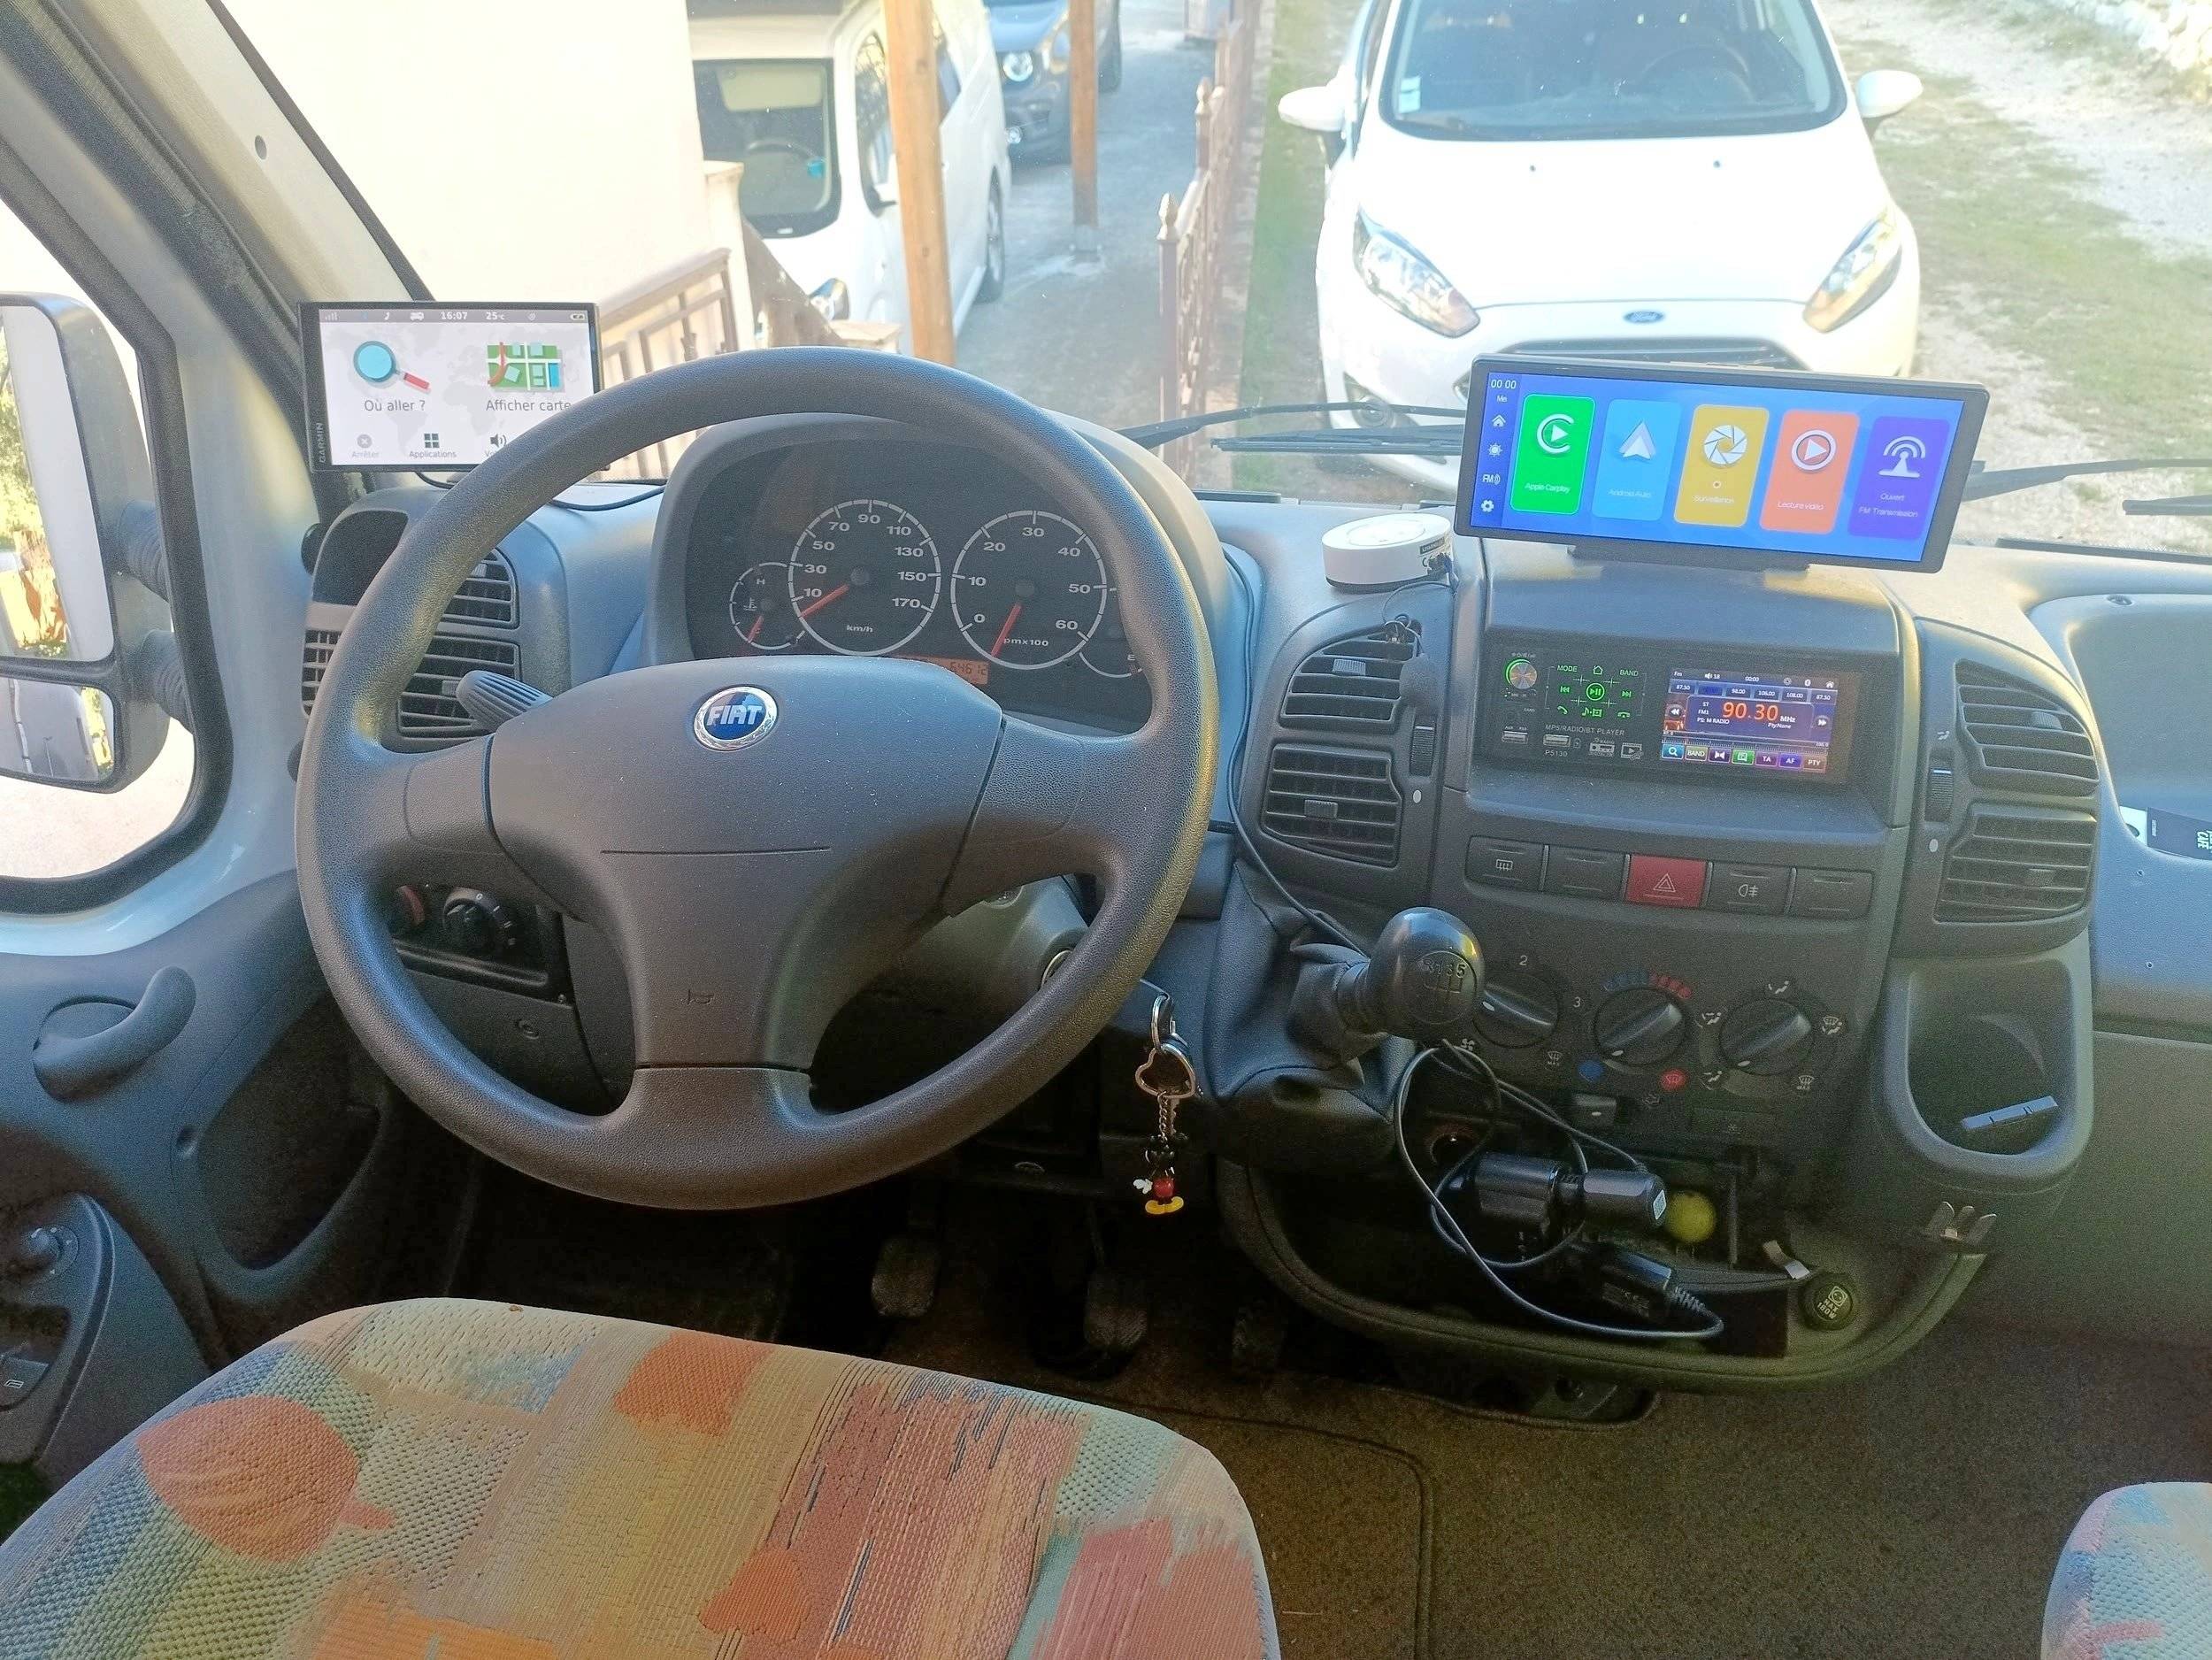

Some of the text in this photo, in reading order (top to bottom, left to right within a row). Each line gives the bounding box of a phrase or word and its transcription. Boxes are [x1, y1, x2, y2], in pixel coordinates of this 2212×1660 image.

[440, 311, 468, 320] 16:07
[364, 398, 382, 411] Où
[388, 400, 415, 411] aller
[486, 399, 572, 411] Afficher carte
[316, 422, 326, 464] GARMIN
[409, 450, 457, 459] Applications
[1777, 500, 1805, 510] Lecture
[1858, 506, 1870, 515] FM
[857, 513, 881, 524] 90
[828, 521, 850, 532] 70
[887, 526, 912, 536] 110
[1022, 526, 1045, 537] 30
[812, 541, 835, 551] 50
[895, 546, 924, 557] 130
[983, 542, 1006, 552] 20
[1057, 547, 1081, 557] 40
[804, 564, 827, 574] 30
[897, 571, 927, 582] 150
[968, 576, 987, 587] 10
[803, 588, 822, 598] 10
[1068, 583, 1091, 594] 50
[892, 597, 921, 609] 170
[973, 613, 986, 624] 0
[846, 625, 874, 634] km/h
[1055, 619, 1079, 630] 60
[706, 704, 763, 726] FIAT
[1722, 702, 1797, 724] 90.30 MHz
[1519, 955, 1528, 966] 2
[1455, 964, 1466, 979] 5
[1573, 996, 1581, 1007] 3
[1817, 1302, 1838, 1319] 180W
